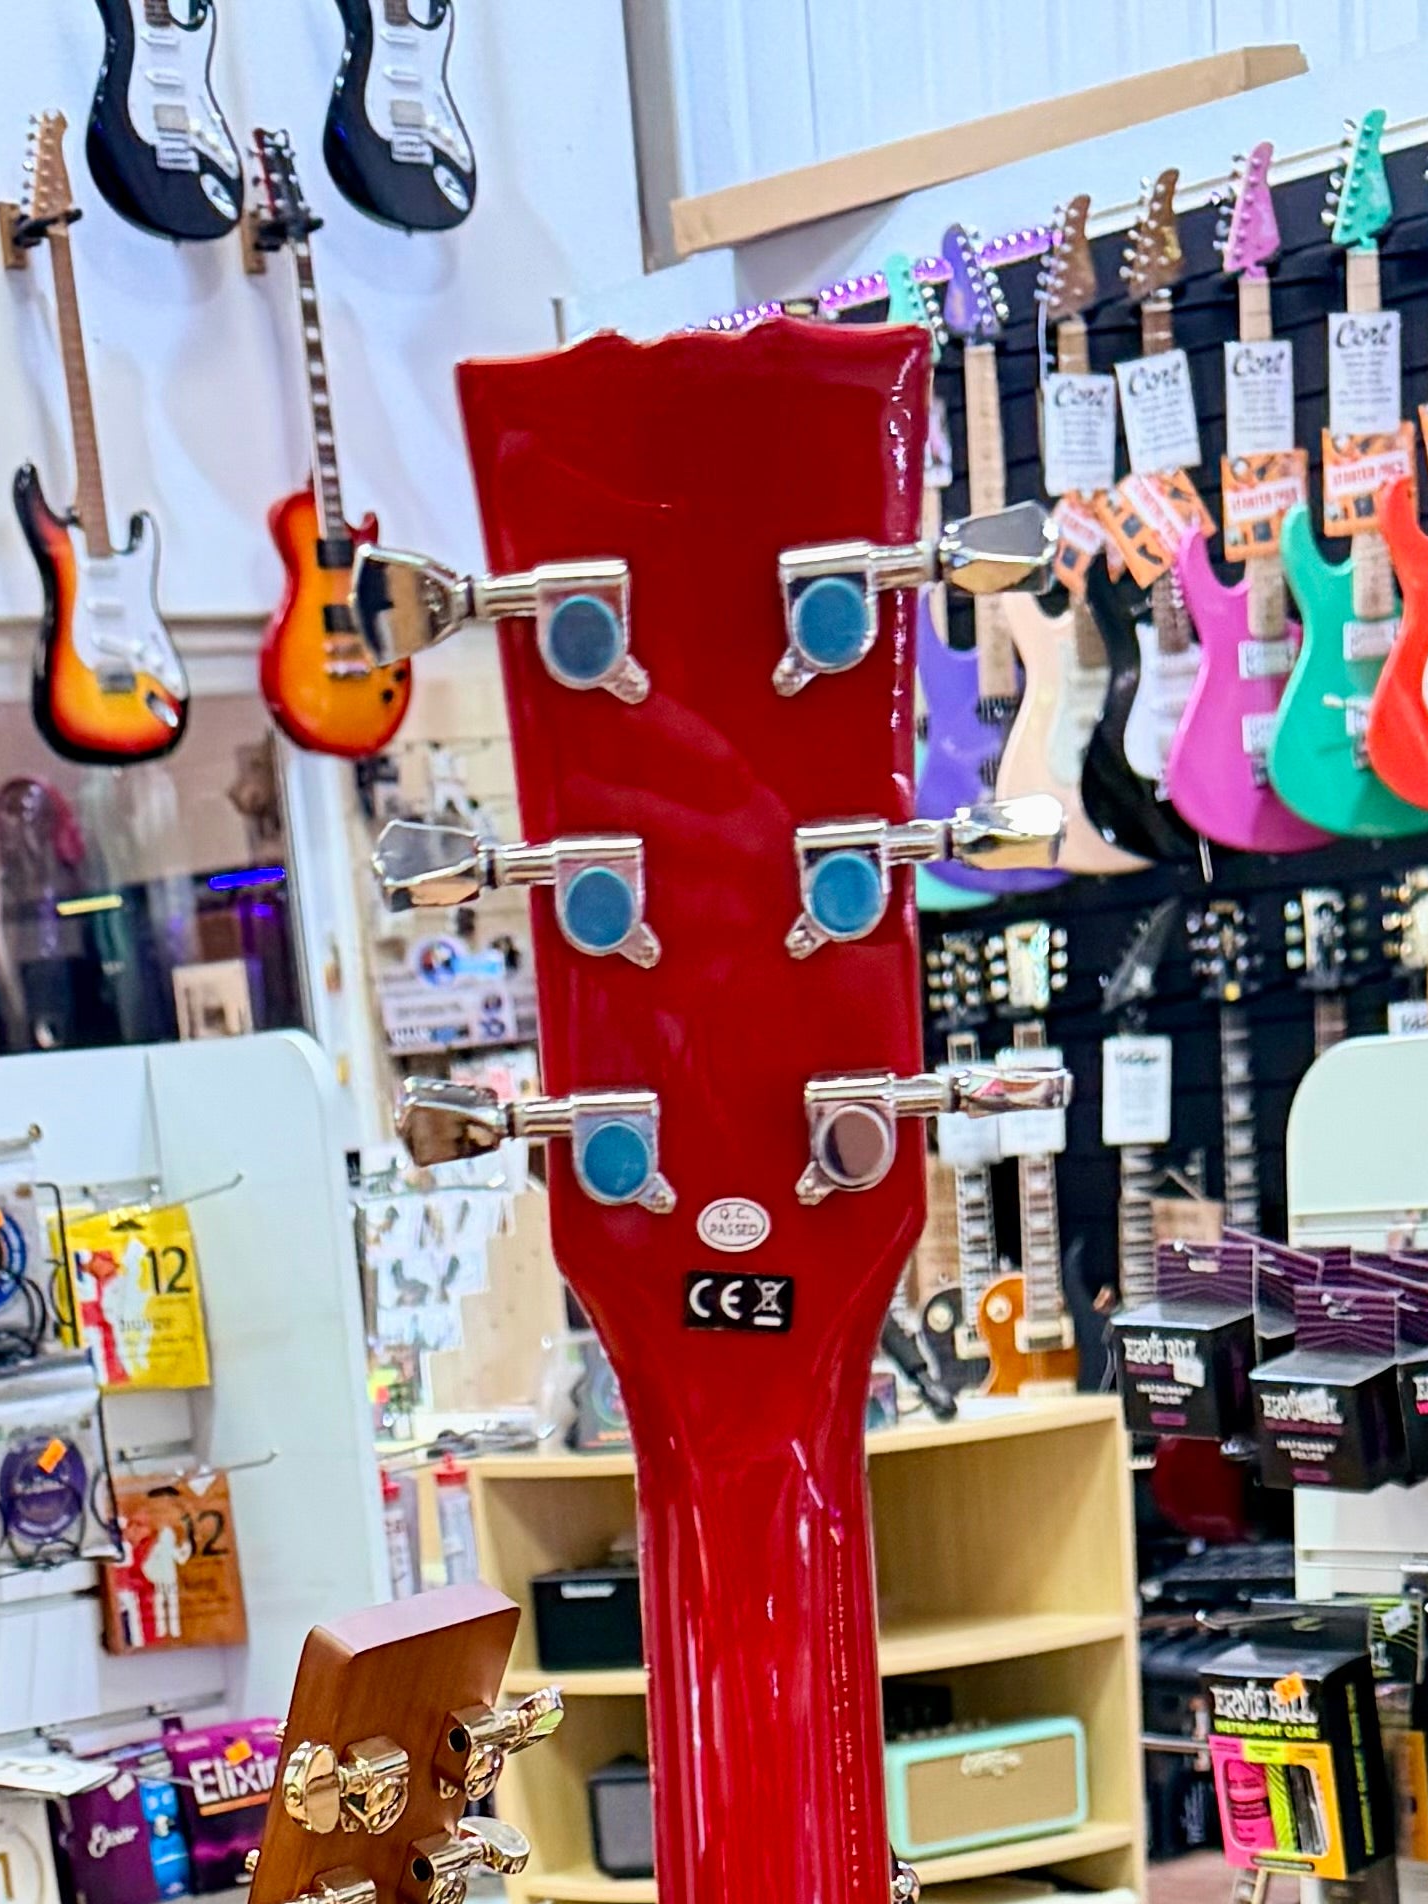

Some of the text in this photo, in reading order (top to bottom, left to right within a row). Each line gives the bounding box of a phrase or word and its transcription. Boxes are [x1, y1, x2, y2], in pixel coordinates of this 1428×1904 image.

[1336, 318, 1392, 349] Cort
[1128, 360, 1181, 397] Cort
[1233, 348, 1285, 378] Cort
[1054, 381, 1108, 408] Cort
[709, 1222, 758, 1237] PASSED
[146, 1245, 191, 1297] 12
[180, 1511, 227, 1558] 12
[1209, 1680, 1266, 1722] ERNIE
